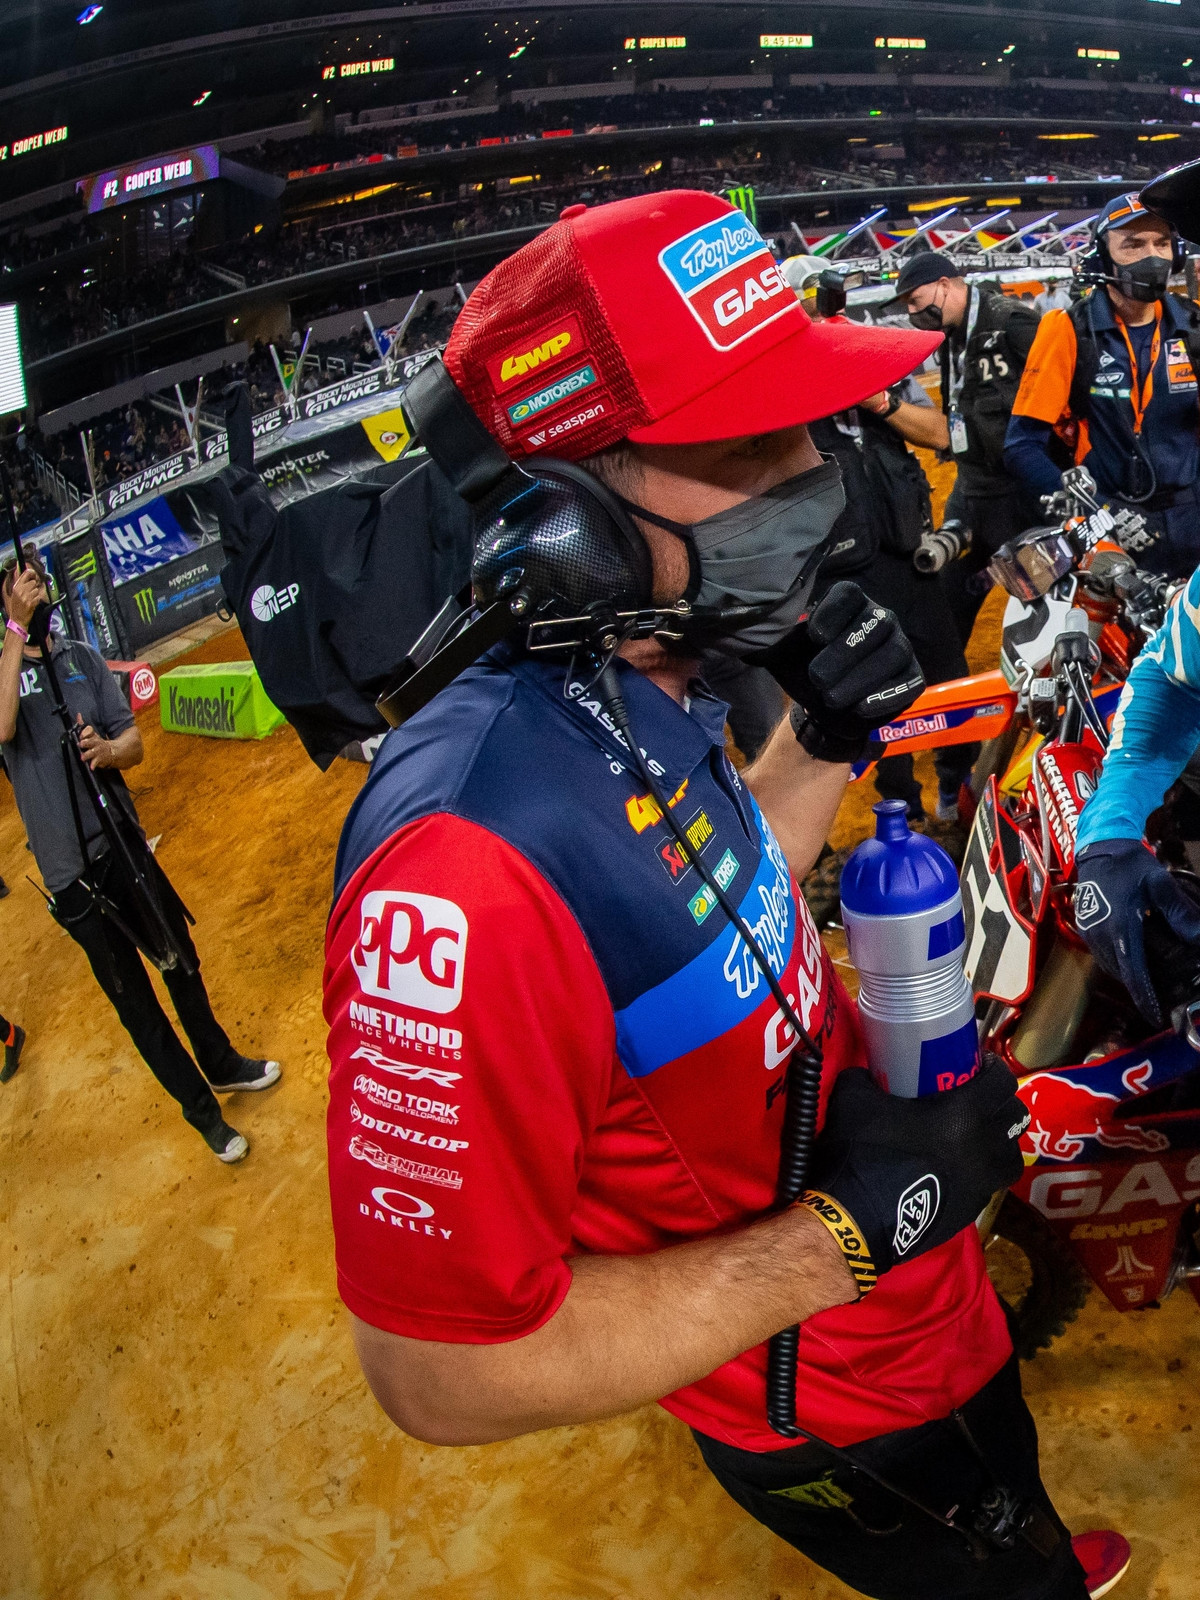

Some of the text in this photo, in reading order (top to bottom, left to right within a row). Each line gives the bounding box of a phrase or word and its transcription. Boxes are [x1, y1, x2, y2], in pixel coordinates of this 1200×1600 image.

[788, 36, 804, 46] PM
[322, 58, 395, 80] #2 COOPER WEBB
[12, 133, 44, 157] COOPER
[45, 126, 69, 146] WEBB
[103, 158, 193, 200] #2 COOPER WEBB
[500, 331, 571, 383] 4WP
[978, 353, 1009, 382] 25
[316, 373, 379, 402] ROCKY MOUNTAIN
[527, 370, 590, 412] MOTOREX
[548, 404, 605, 438] seaspan
[119, 455, 183, 494] ROCKY MOUNTAIN
[168, 563, 210, 588] MONSTER
[846, 618, 878, 647] Troy Lee
[168, 685, 236, 733] Kawasaki
[866, 682, 909, 704] ACE
[878, 712, 949, 743] Red Bull
[705, 853, 740, 907] MTOREX
[353, 900, 460, 990] PPG
[350, 1000, 463, 1050] METHOD
[350, 1020, 462, 1061] RACE WHEELS
[350, 1046, 463, 1089] RZR
[367, 1093, 460, 1126] RACING DEVELOPMENT
[368, 1081, 461, 1119] PRO TORK
[360, 1115, 470, 1153] DUNLOP
[373, 1149, 464, 1184] RENTHAL
[359, 1202, 453, 1241] OAKLEY
[834, 1226, 862, 1252] 10
